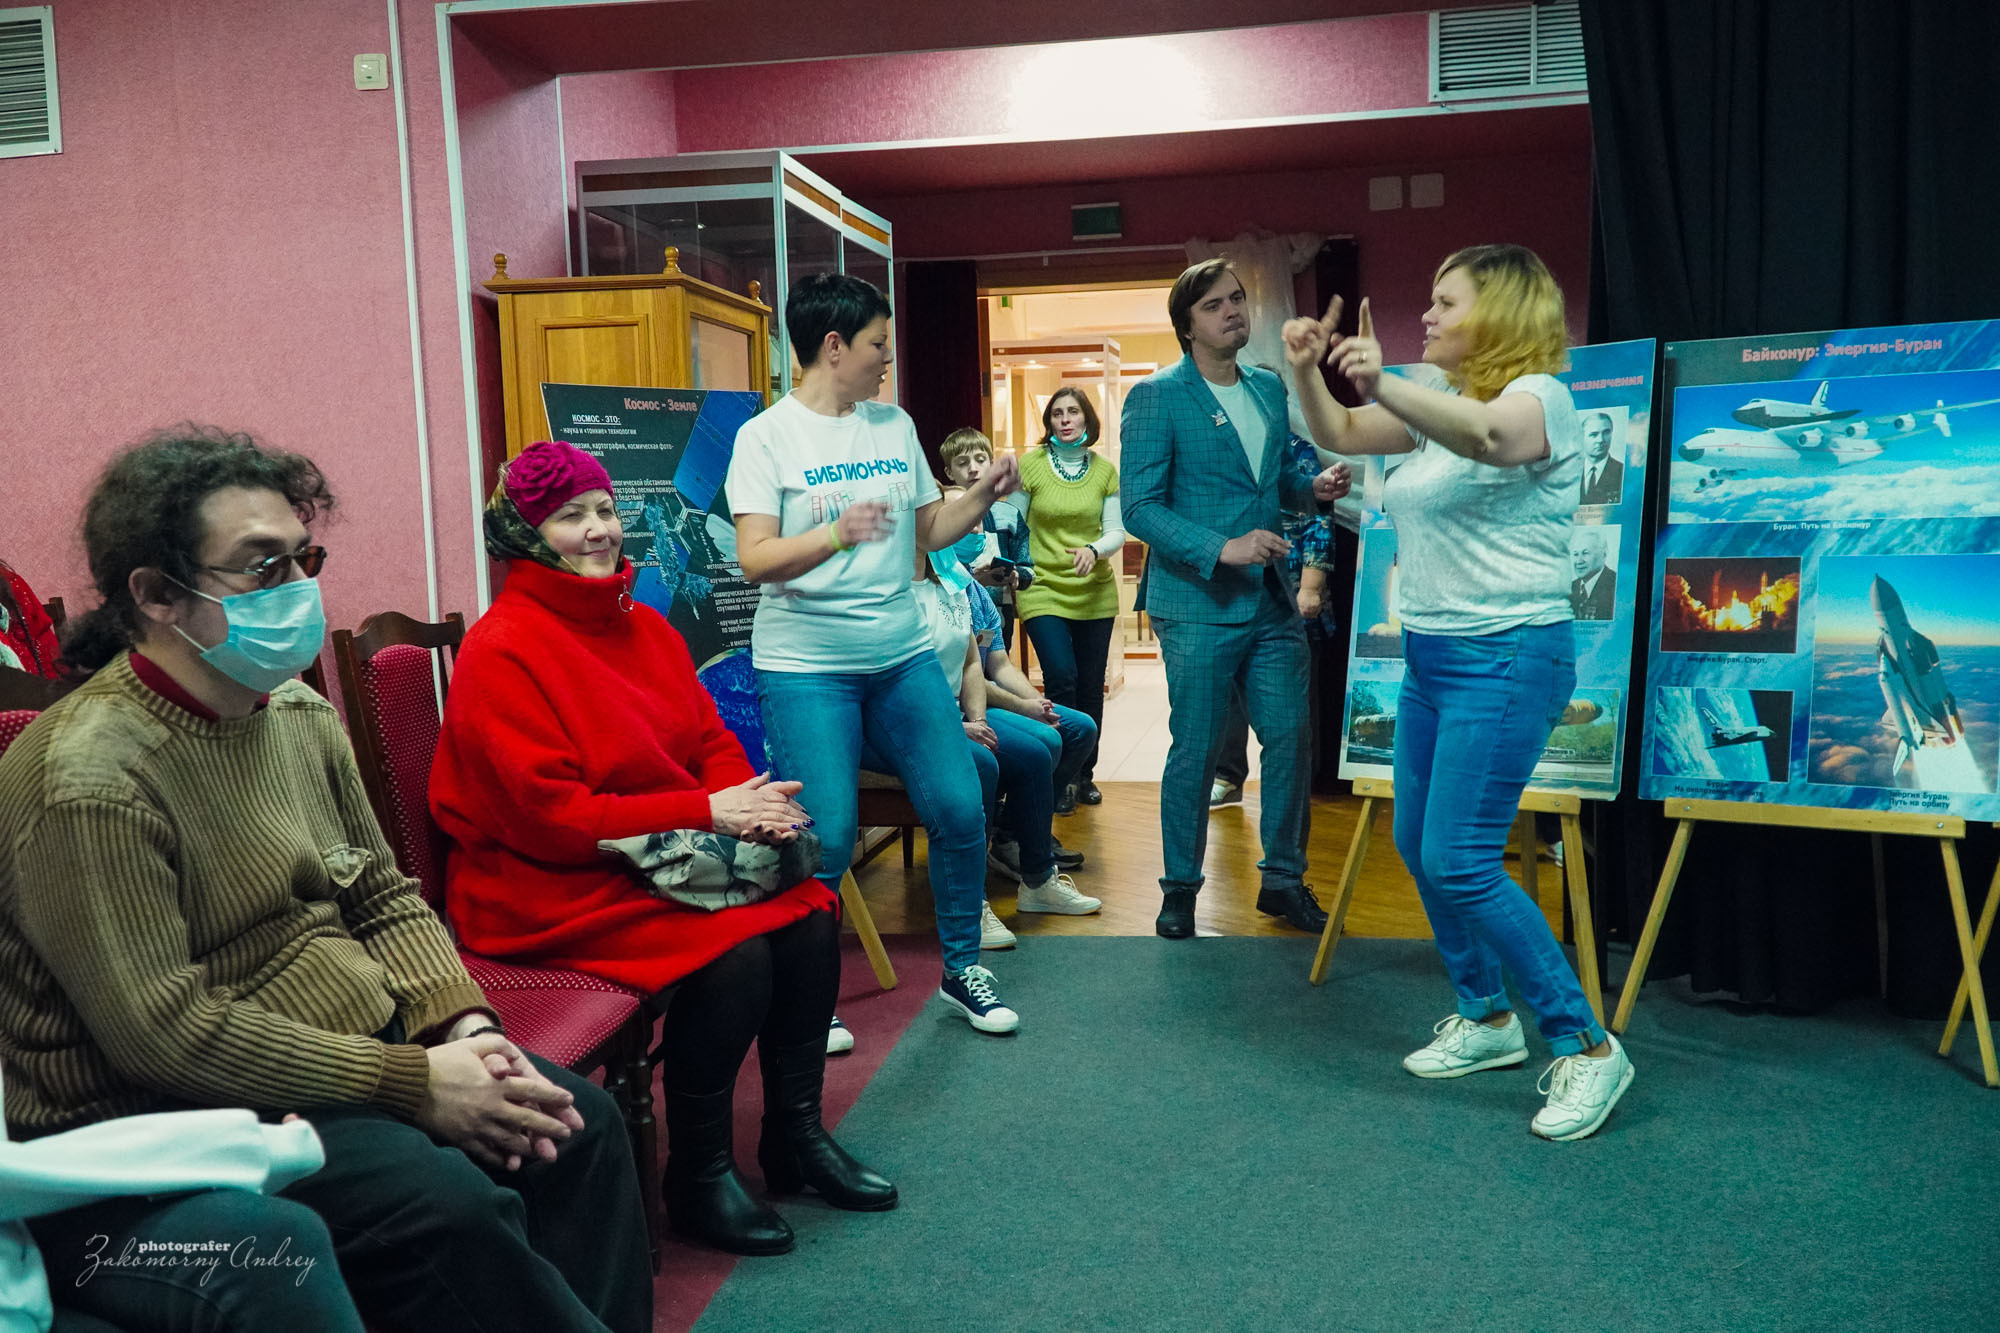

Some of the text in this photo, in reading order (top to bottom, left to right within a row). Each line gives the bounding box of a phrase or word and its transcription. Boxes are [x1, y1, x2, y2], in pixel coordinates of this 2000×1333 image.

[1742, 338, 1942, 362] Байконур: Энергия-Буран
[1571, 375, 1644, 391] назначения
[624, 398, 660, 411] Космос
[667, 399, 698, 412] Земле
[572, 414, 600, 423] КОСМОС
[605, 415, 621, 424] ЭТО:
[804, 458, 908, 486] БИБЛИОНОЧЬ
[611, 478, 643, 486] ологической
[1801, 522, 1819, 530] Путь
[1922, 800, 1950, 809] орбиту
